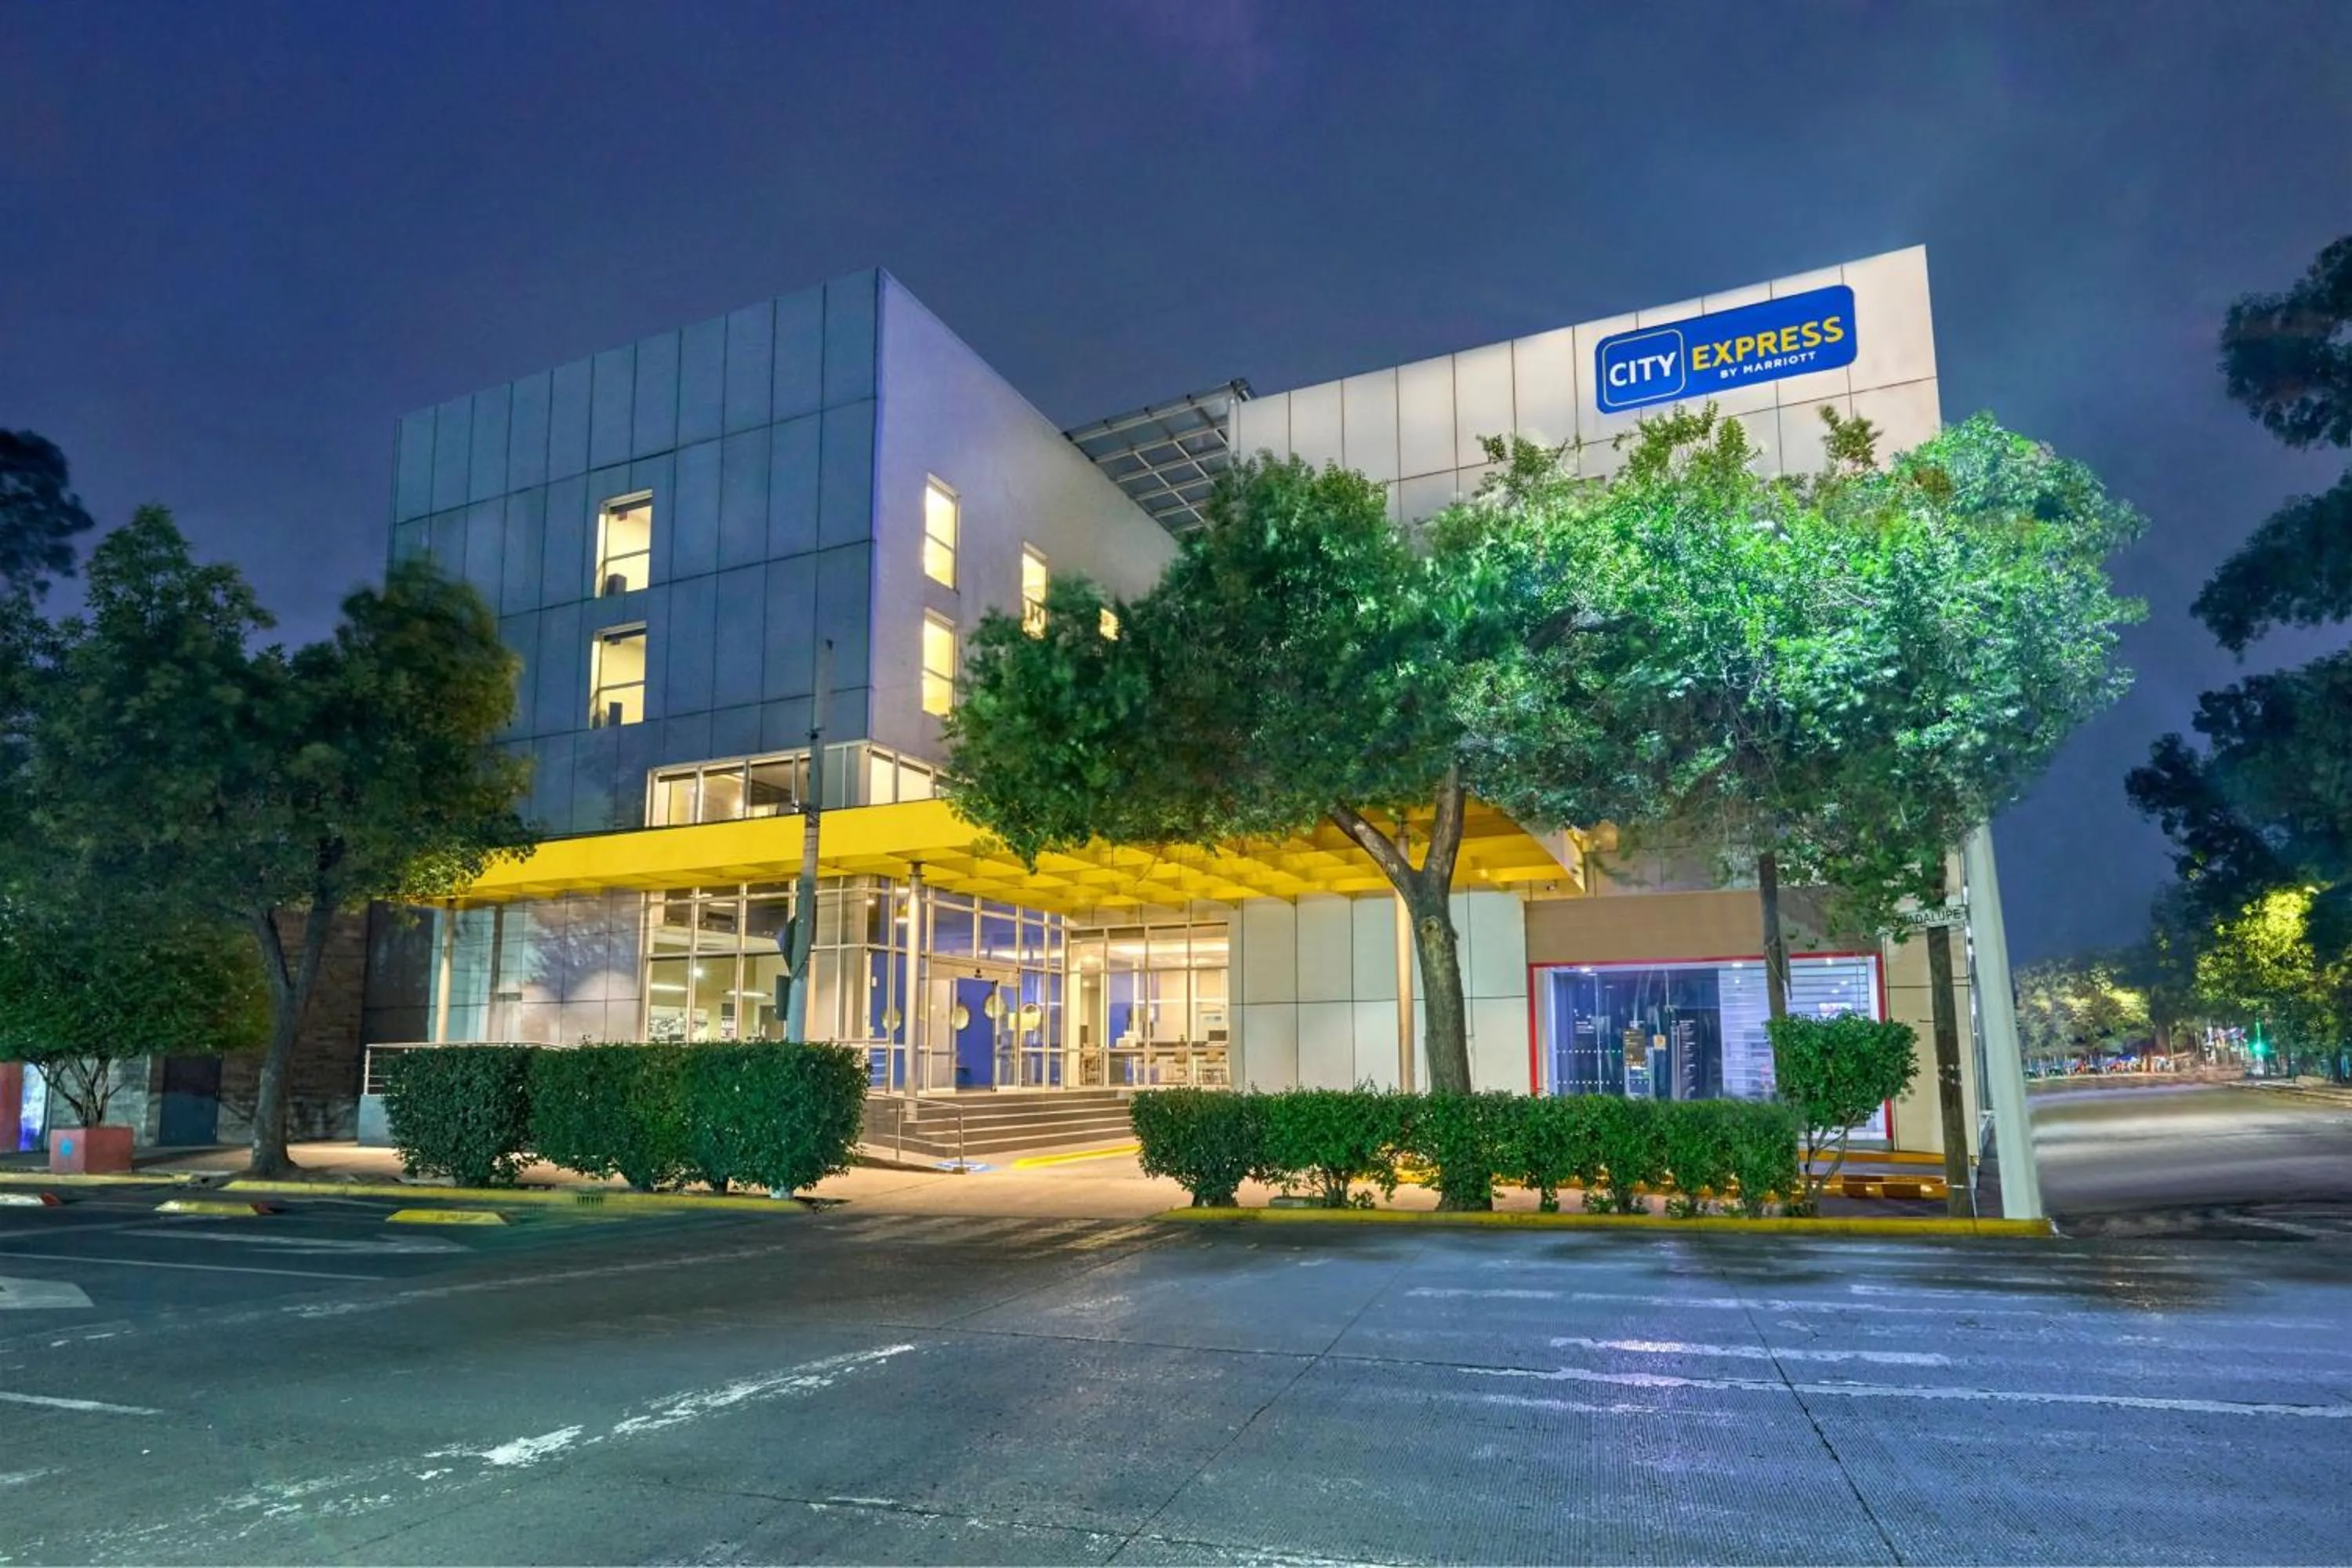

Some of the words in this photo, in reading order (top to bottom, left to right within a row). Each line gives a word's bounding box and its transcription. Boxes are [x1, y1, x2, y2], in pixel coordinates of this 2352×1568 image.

[1610, 350, 1677, 387] CITY
[1692, 316, 1844, 371] EXPRESS
[1719, 367, 1738, 379] BY
[1742, 350, 1817, 374] MARRIOTT
